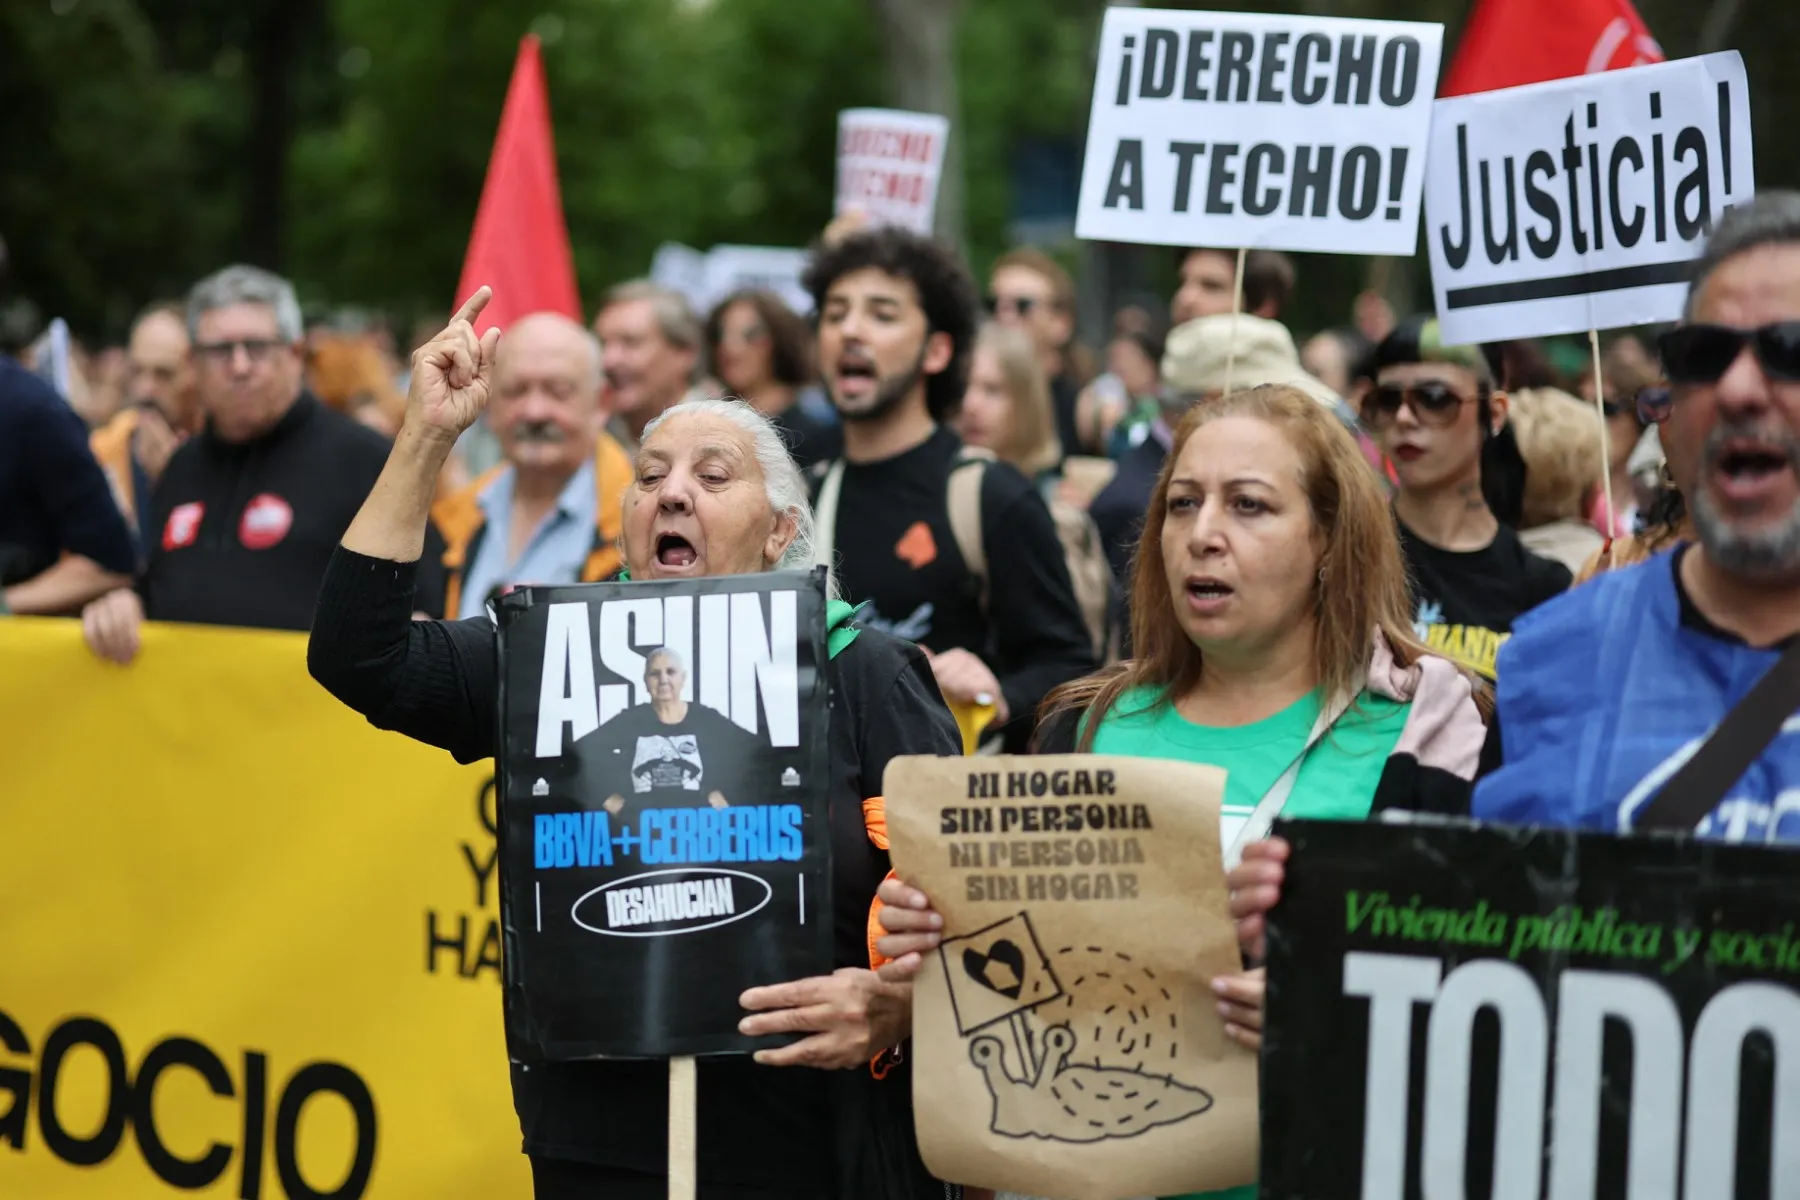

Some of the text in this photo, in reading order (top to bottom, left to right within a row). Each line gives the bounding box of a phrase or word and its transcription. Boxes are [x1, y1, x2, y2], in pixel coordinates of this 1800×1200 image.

[1115, 28, 1421, 107] ¡DERECHO
[1102, 139, 1409, 221] A TECHO!
[1441, 81, 1735, 270] Justicia!
[535, 590, 800, 758] ASUN
[940, 803, 1153, 835] SIN PERSONA
[967, 769, 1117, 799] NI HOGAR
[949, 837, 1146, 868] NI PERSONA
[966, 872, 1140, 902] SIN HOGAR
[606, 877, 735, 928] DESAHUCIAN
[1345, 890, 1506, 945] Vivienda
[1508, 903, 1662, 960] pública
[1660, 928, 1702, 974] y
[1342, 951, 1800, 1200] TODO
